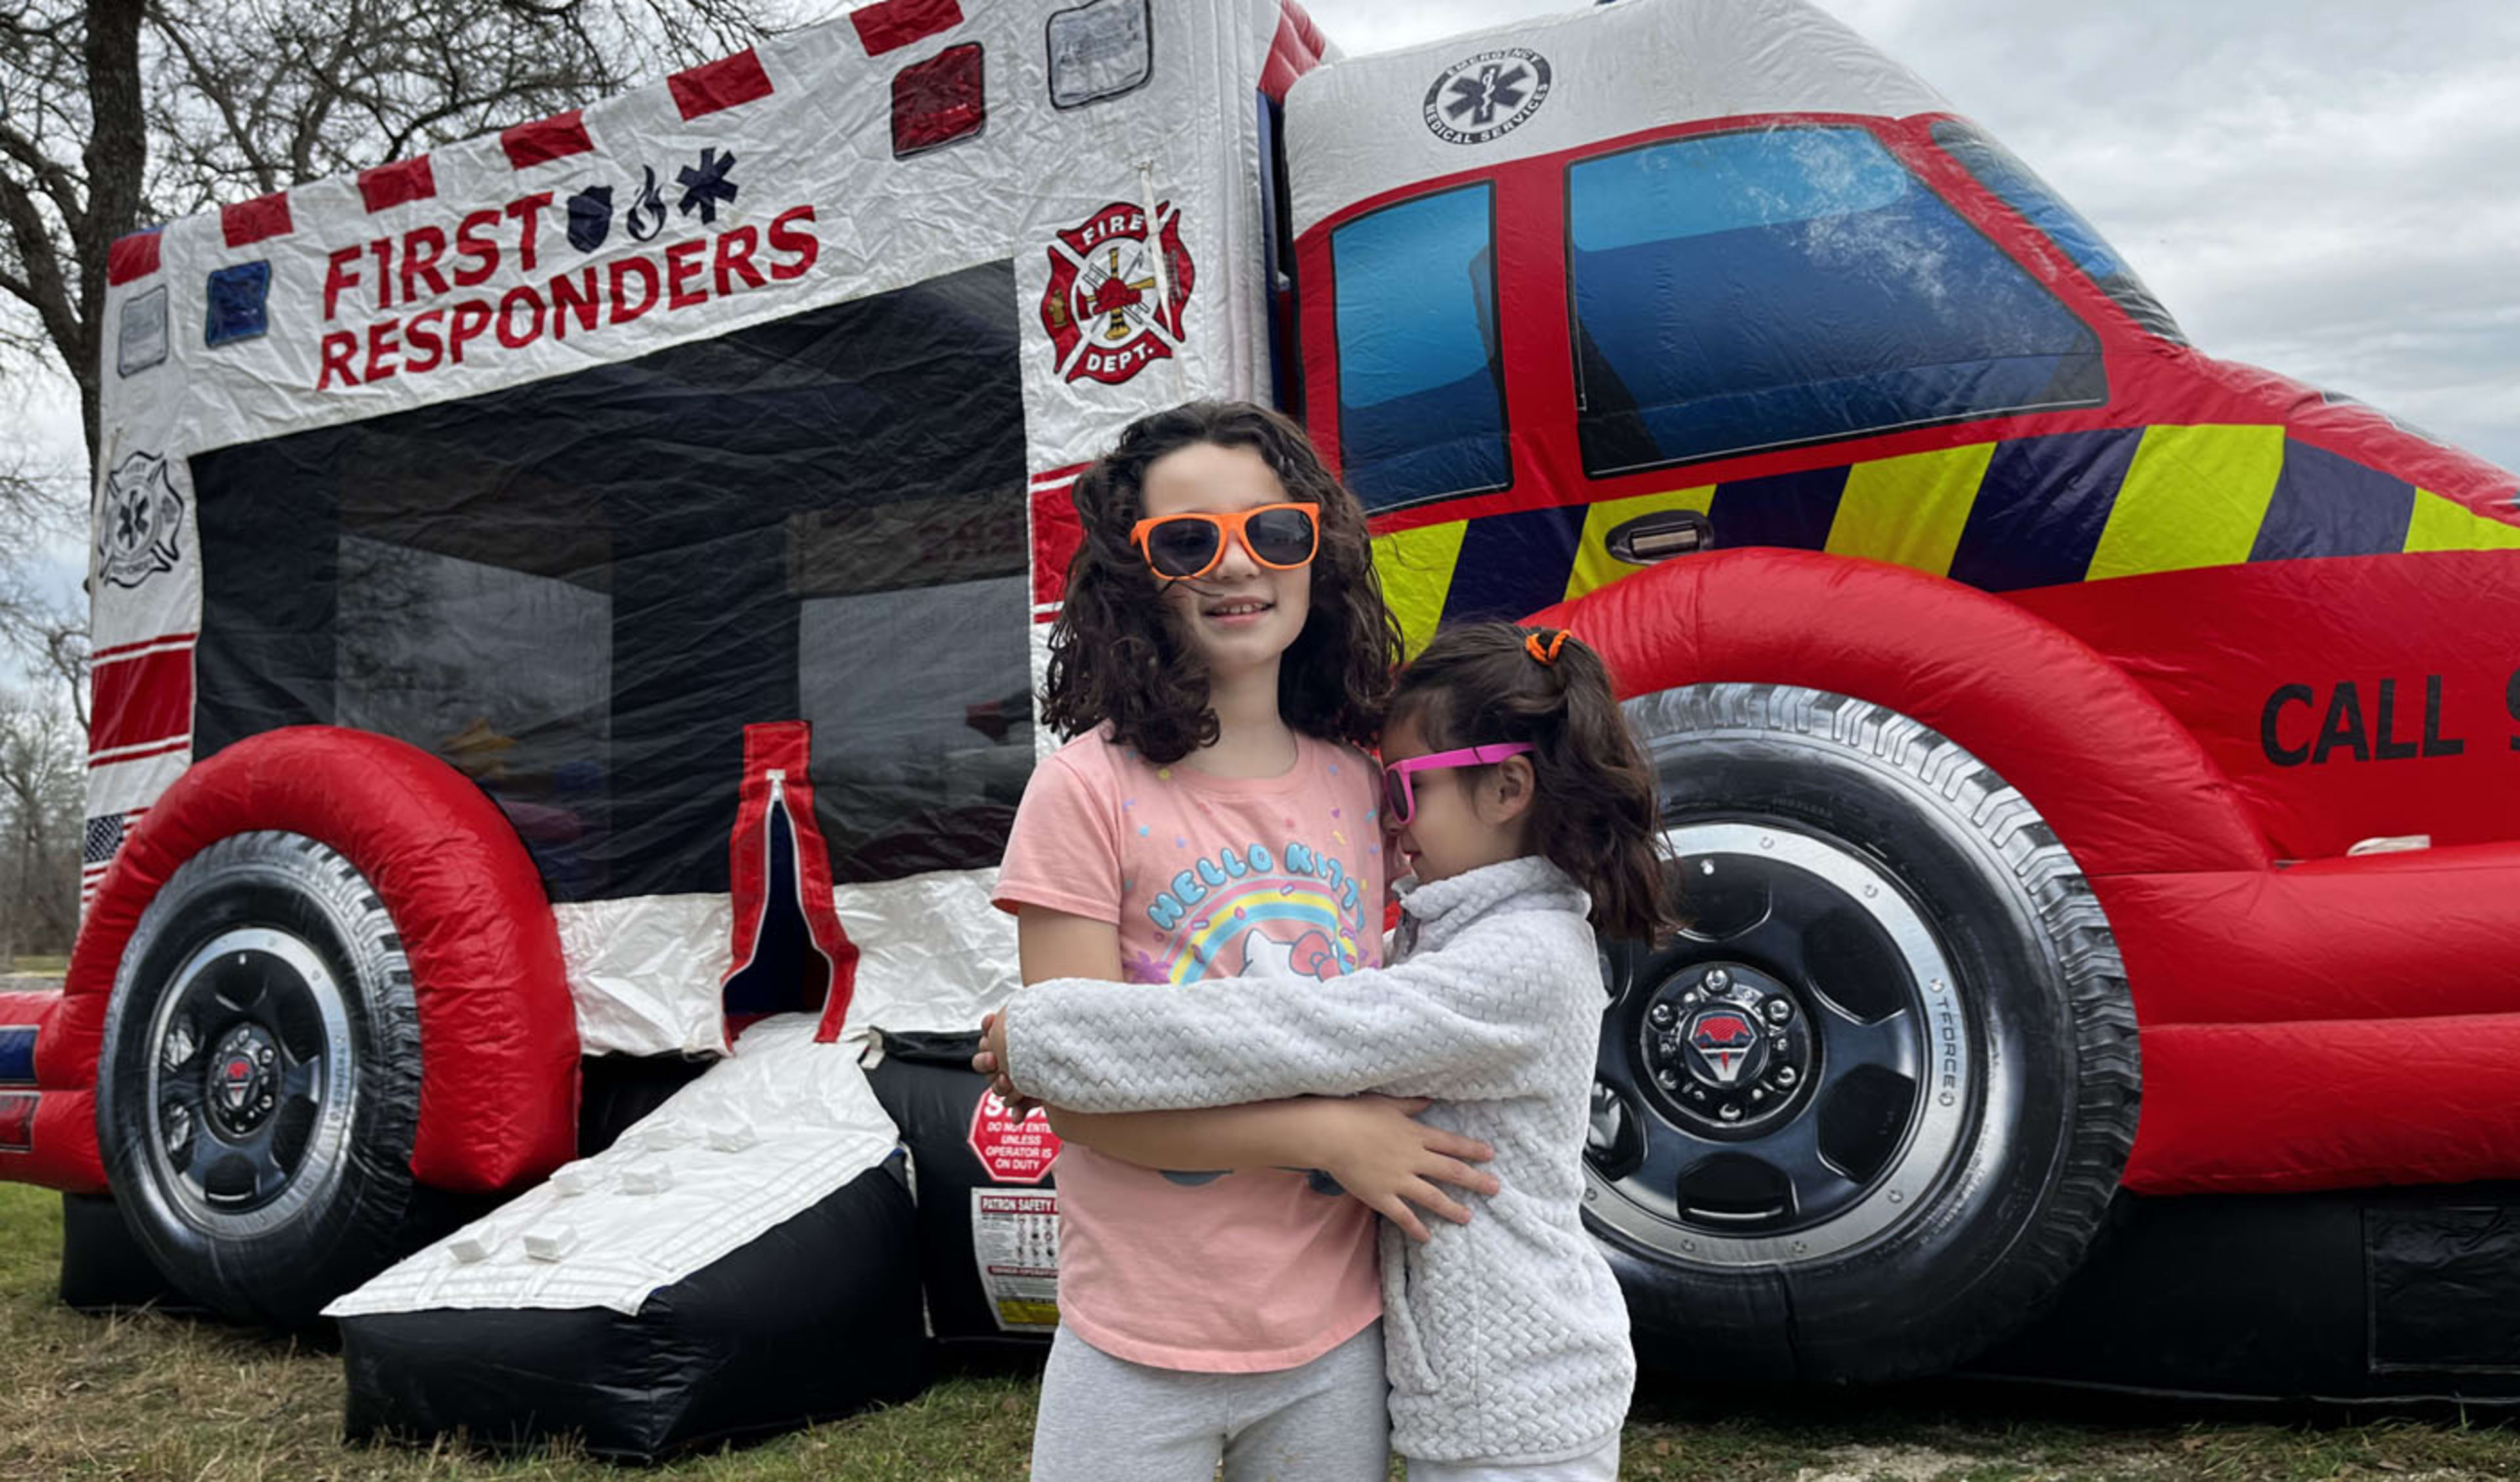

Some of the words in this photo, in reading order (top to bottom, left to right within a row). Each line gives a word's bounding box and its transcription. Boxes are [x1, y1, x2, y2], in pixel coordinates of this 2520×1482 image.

[1425, 103, 1472, 143] MEDICAL
[1480, 84, 1549, 141] SERVICES
[1082, 214, 1144, 246] FIRE
[317, 205, 820, 391] RESPONDERS
[1086, 343, 1154, 372] DEPT.
[2261, 675, 2464, 768] CALL
[1147, 843, 1273, 931] HELLO
[1937, 997, 1957, 1090] TFORCE
[986, 1121, 1002, 1132] DO
[1025, 1122, 1053, 1133] ENTE
[1001, 1134, 1042, 1145] UNLESS
[985, 1145, 1040, 1158] OPERATOR
[1041, 1148, 1053, 1158] IS
[995, 1158, 1011, 1169] ON
[1012, 1158, 1040, 1170] DUTY
[1018, 1199, 1051, 1212] SAFETY
